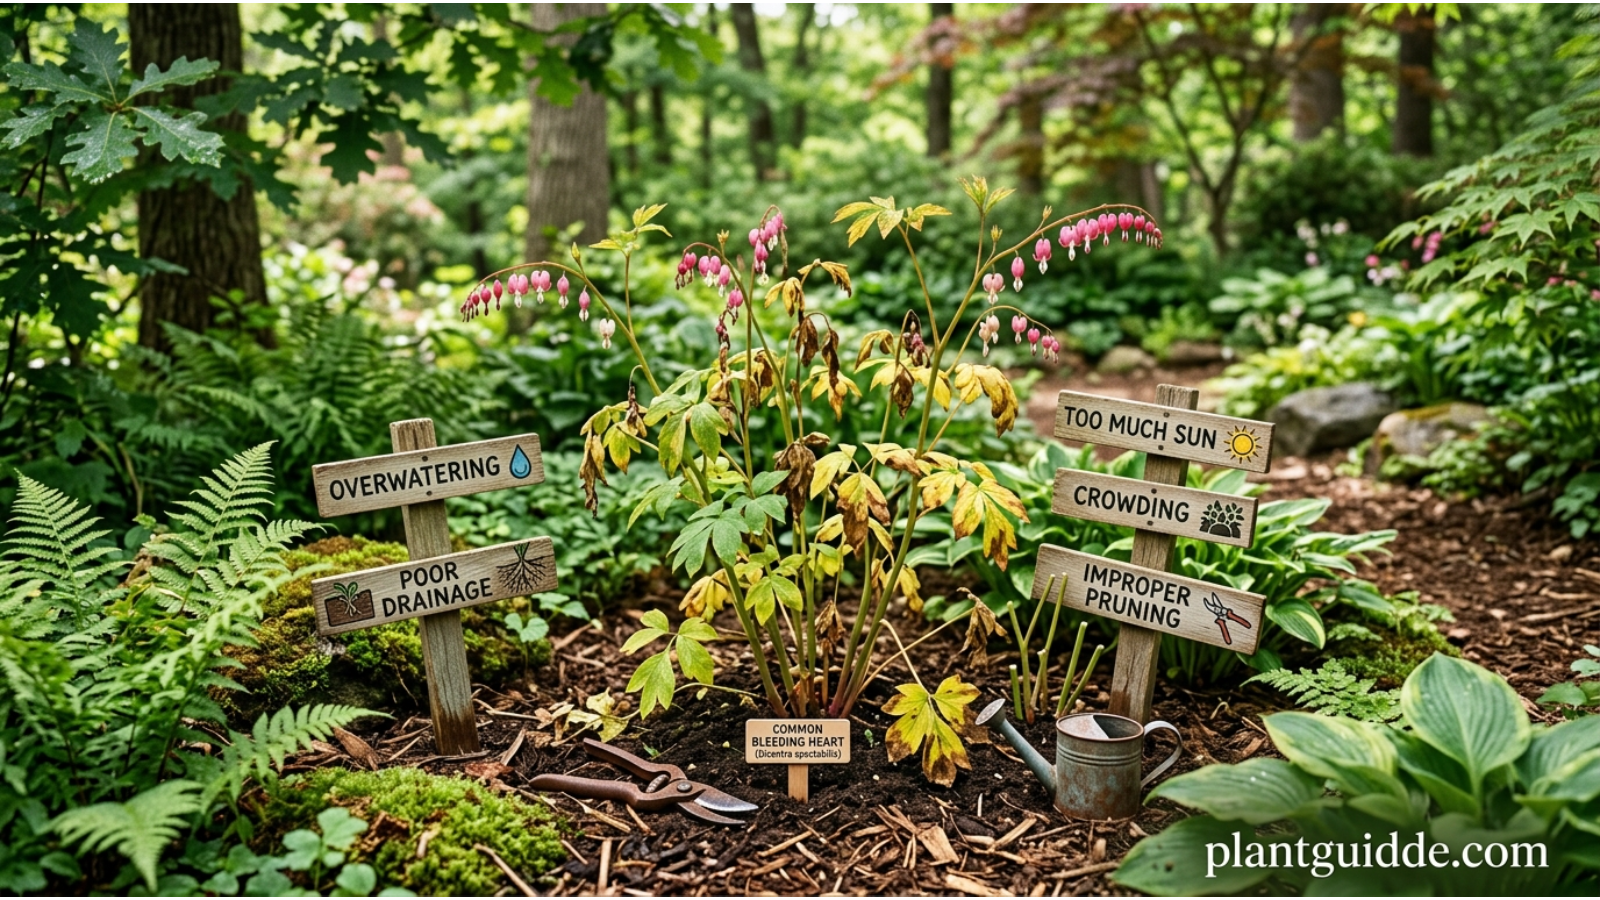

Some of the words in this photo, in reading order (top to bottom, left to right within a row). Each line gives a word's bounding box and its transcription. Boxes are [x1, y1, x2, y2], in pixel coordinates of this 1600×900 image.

[1064, 406, 1103, 430] TOO
[1108, 413, 1168, 441] MUCH
[1173, 424, 1218, 450] SUN
[329, 455, 501, 501] OVERWATERING
[1073, 485, 1190, 523] CROWDING
[400, 561, 460, 590] POOR
[1083, 563, 1192, 607] IMPROPER
[381, 577, 494, 617] DRAINAGE
[1085, 587, 1181, 629] PRUNING
[751, 736, 806, 747] BLEEDING
[808, 736, 845, 747] HEART
[772, 724, 823, 734] COMMON
[755, 749, 793, 759] (Dicentra
